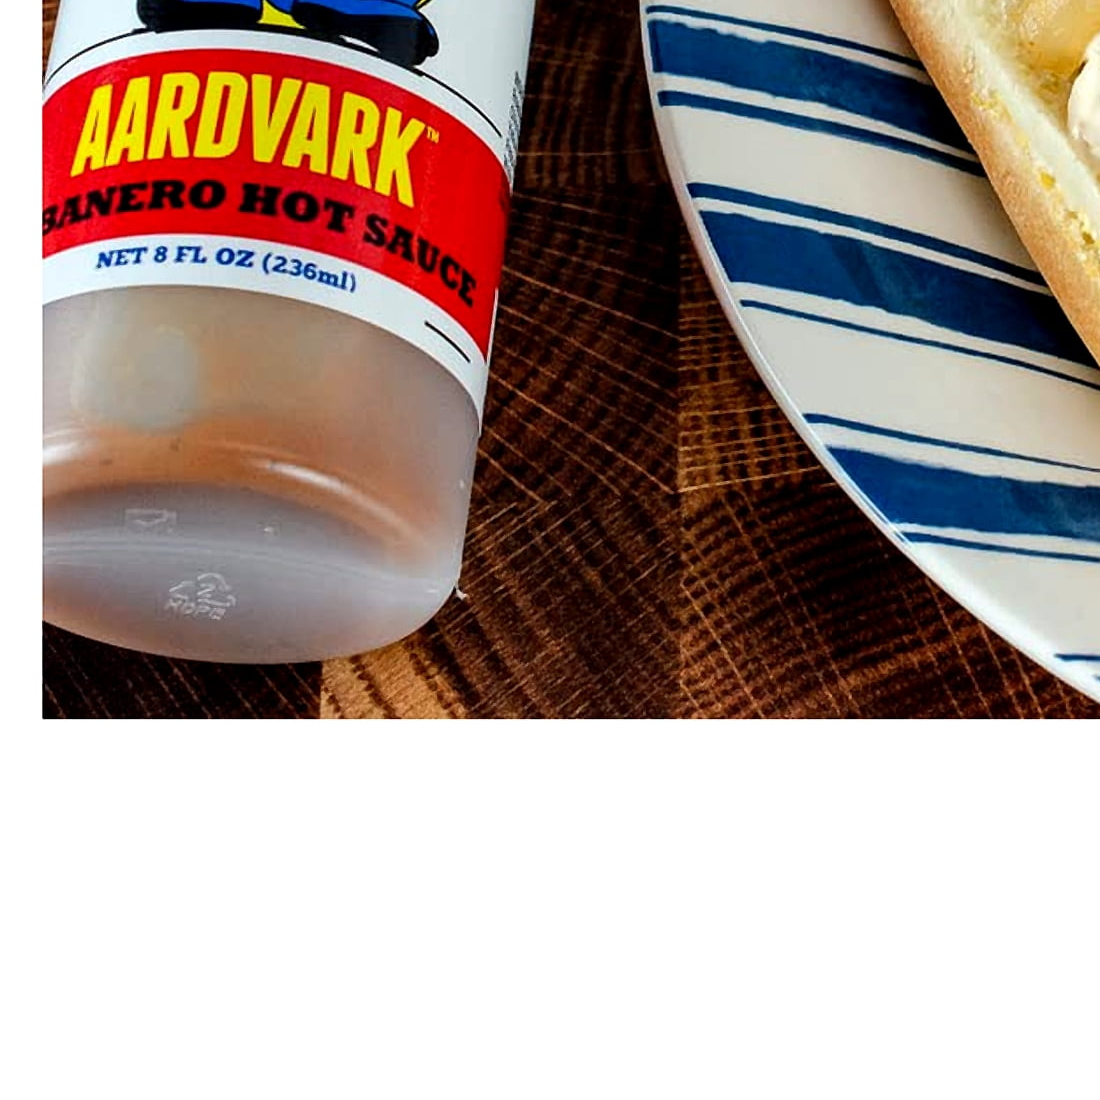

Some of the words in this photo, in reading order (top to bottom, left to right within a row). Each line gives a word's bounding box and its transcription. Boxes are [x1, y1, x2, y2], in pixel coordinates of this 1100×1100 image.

[69, 71, 426, 208] AARDVARK
[95, 246, 149, 269] NET
[153, 245, 169, 264] 8
[174, 245, 208, 264] FL
[215, 247, 256, 268] OZ
[261, 252, 358, 294] (236ml)
[238, 182, 355, 234] HOT
[362, 212, 477, 308] SAUCE
